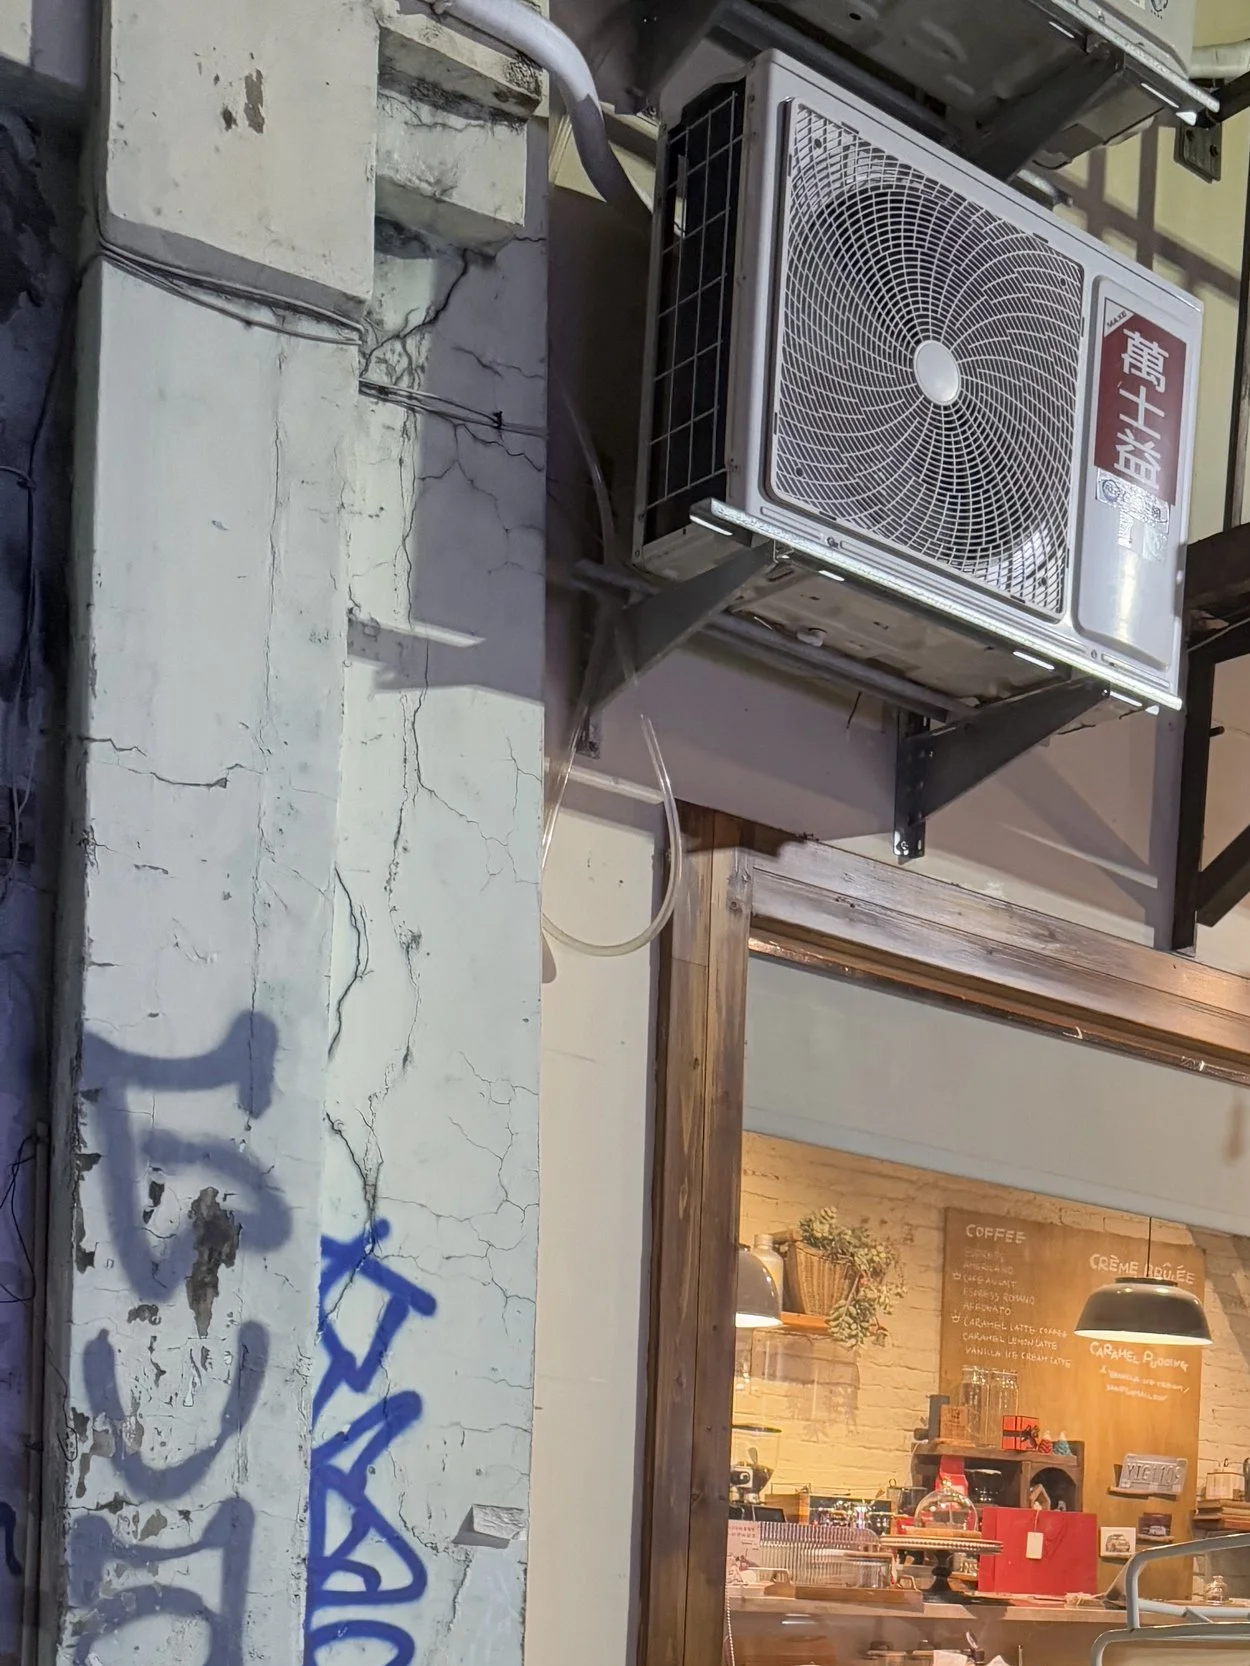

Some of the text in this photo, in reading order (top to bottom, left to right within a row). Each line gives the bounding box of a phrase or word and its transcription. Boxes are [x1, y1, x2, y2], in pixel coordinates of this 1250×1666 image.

[1113, 328, 1170, 490] 萬士益
[965, 1223, 1027, 1244] COFFEE
[1089, 1253, 1140, 1275] CRÈME
[963, 1316, 1007, 1331] CARAMEL
[1010, 1323, 1036, 1335] LATTE
[962, 1331, 1057, 1351] CARAMEL LEMON LATTE
[965, 1344, 1001, 1357] VANILLA
[1021, 1352, 1048, 1362] CREAM
[1049, 1356, 1072, 1368] LATTE
[1089, 1341, 1189, 1373] CARAMEL PUDDING
